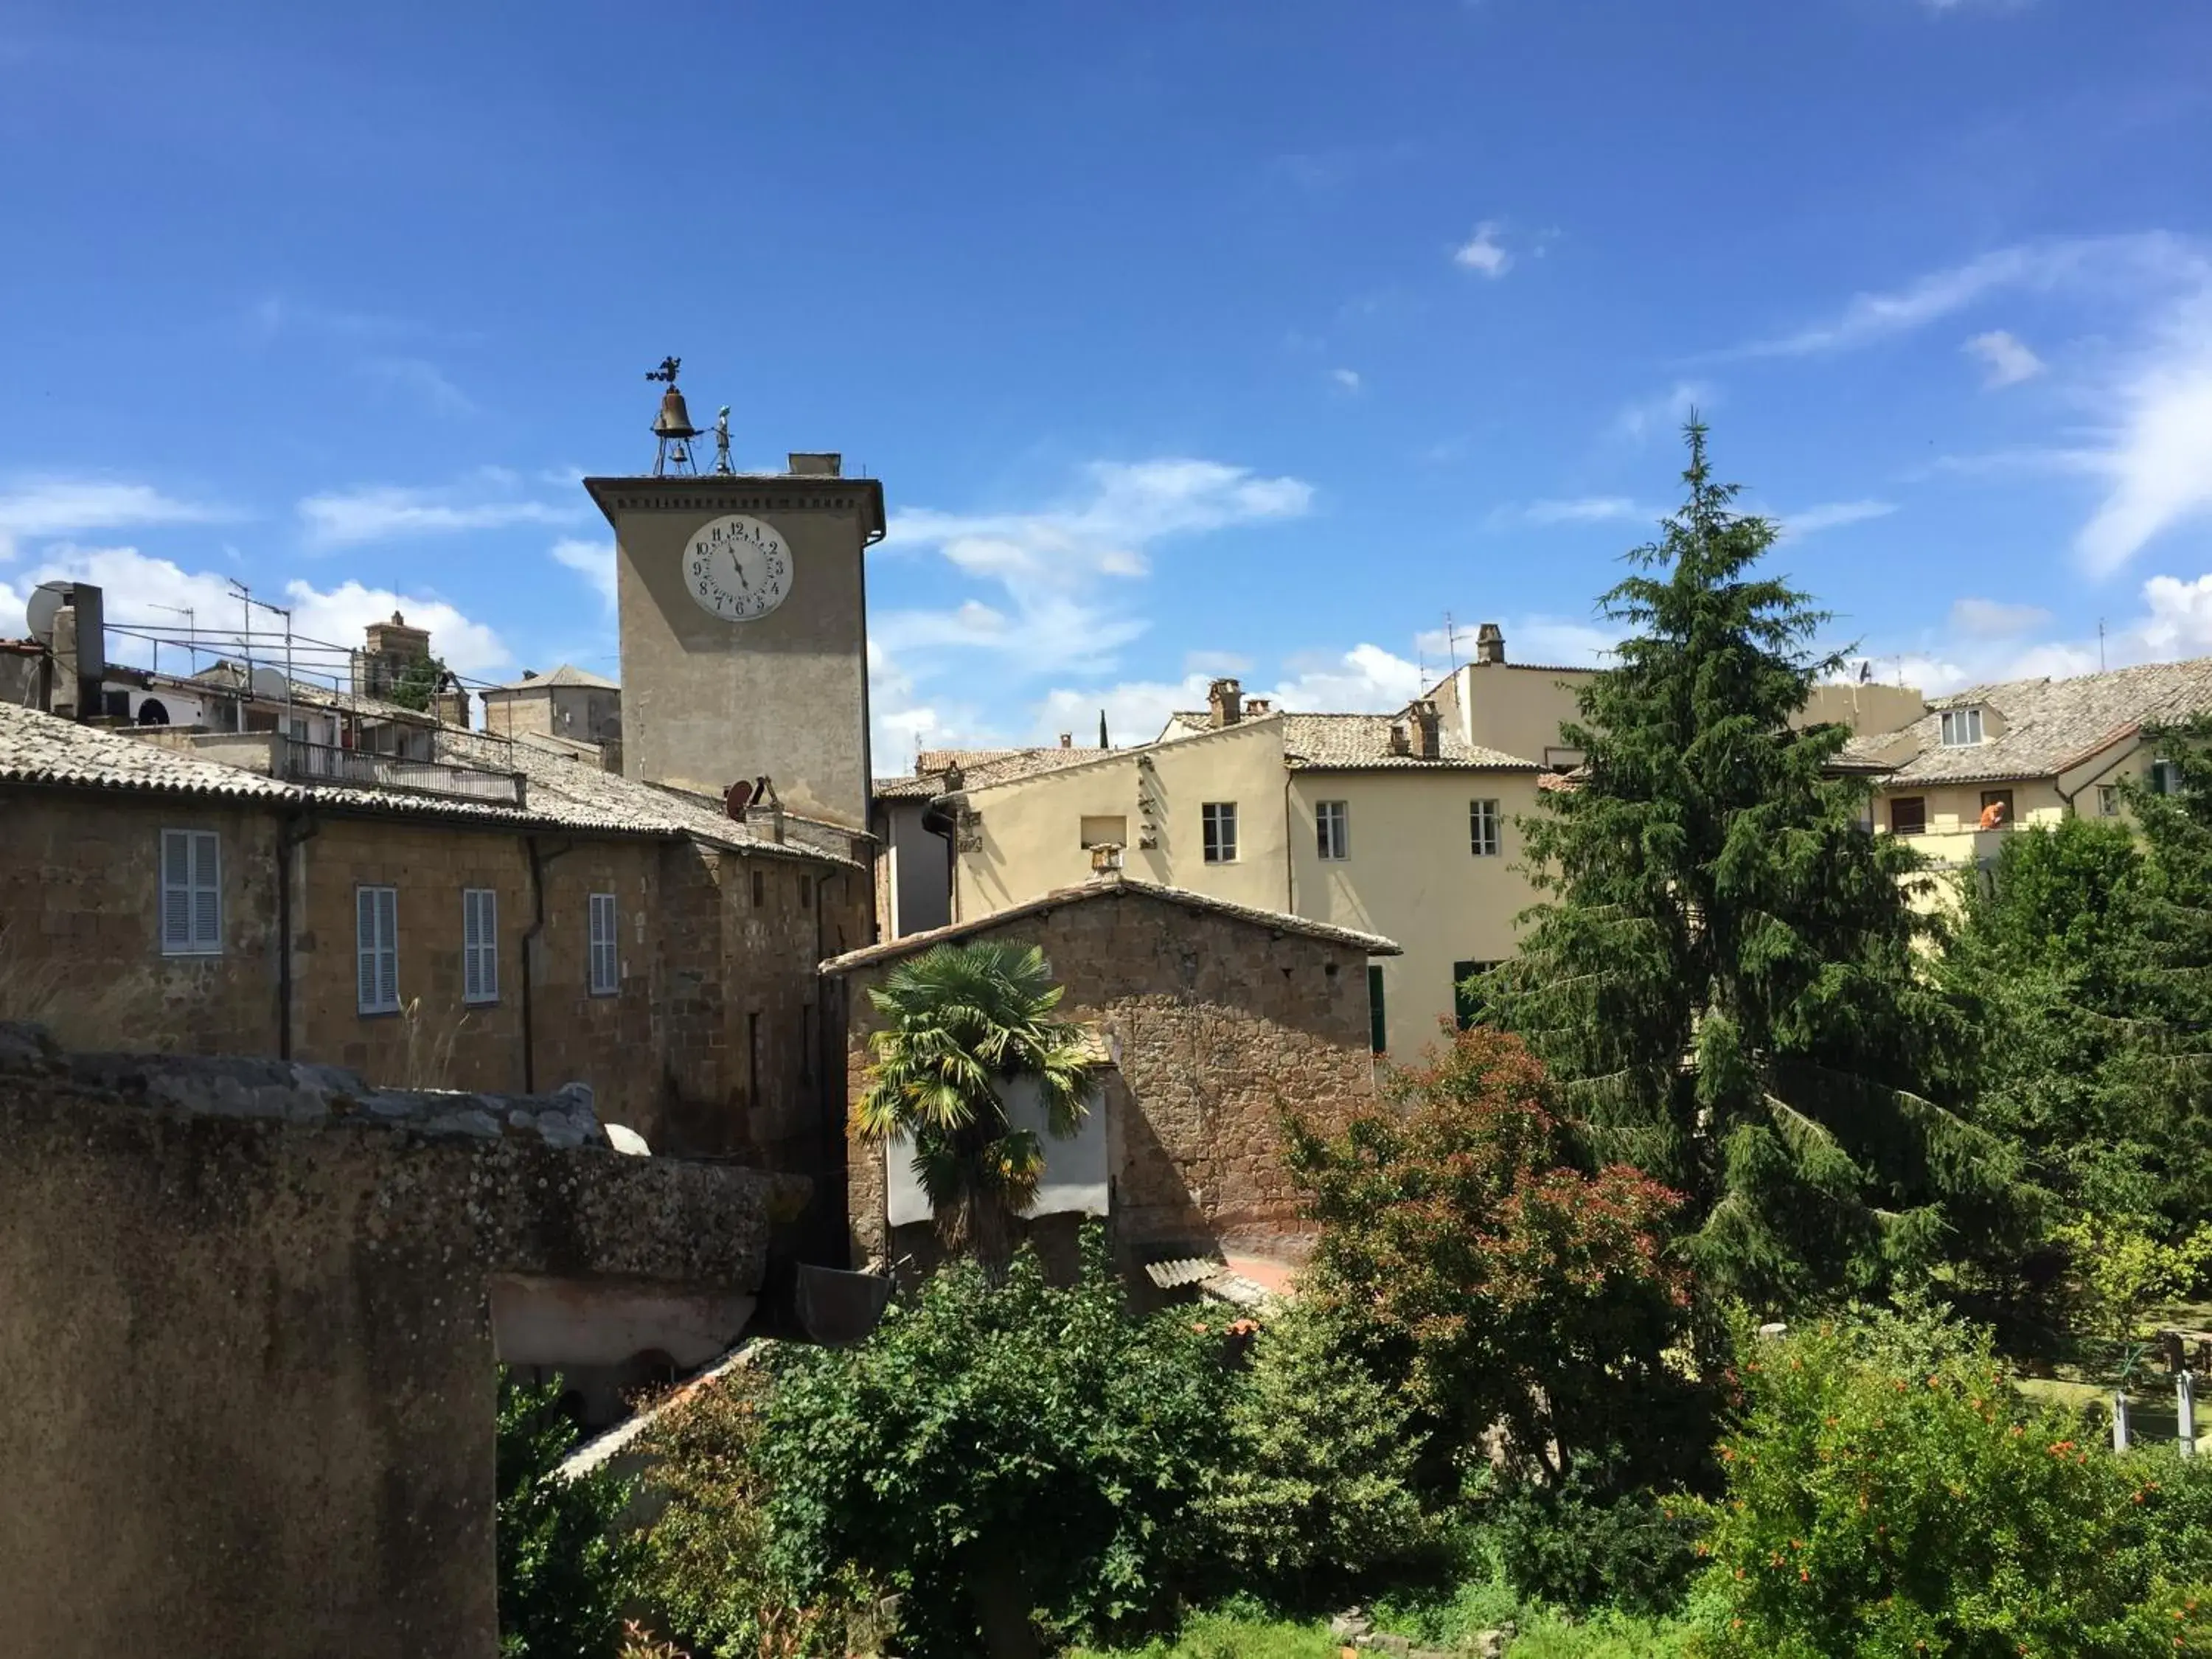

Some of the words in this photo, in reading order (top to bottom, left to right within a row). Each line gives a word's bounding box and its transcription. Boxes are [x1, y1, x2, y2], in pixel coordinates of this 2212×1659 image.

[712, 527, 721, 540] 11
[731, 522, 744, 535] 12
[755, 526, 760, 540] 1
[696, 542, 709, 555] 10
[769, 541, 779, 555] 2
[693, 562, 702, 576] 9
[776, 560, 784, 575] 3
[699, 581, 708, 595] 8
[771, 582, 779, 595] 4
[715, 597, 723, 610] 7
[736, 602, 744, 615] 6
[757, 597, 765, 610] 5
